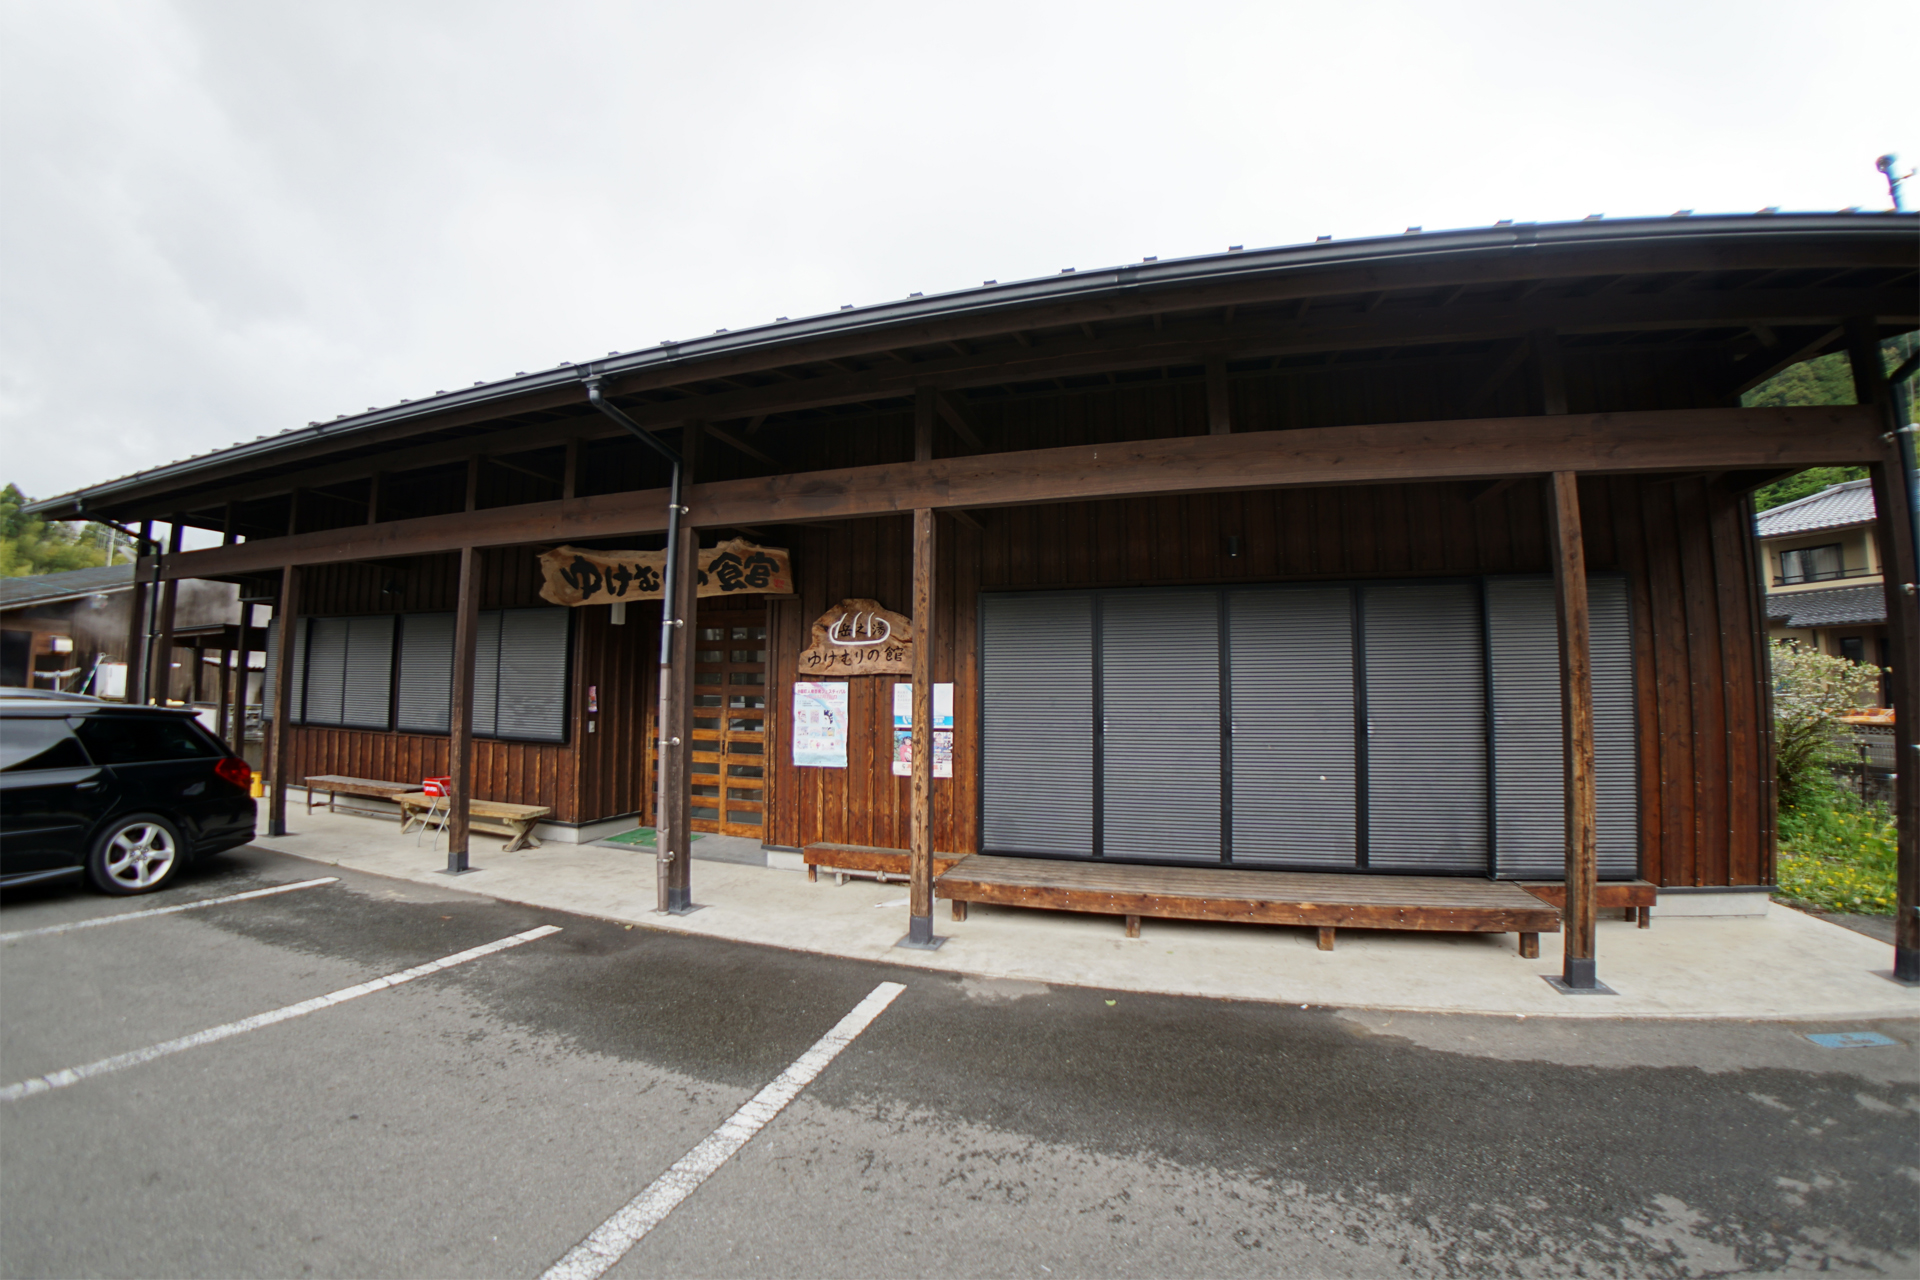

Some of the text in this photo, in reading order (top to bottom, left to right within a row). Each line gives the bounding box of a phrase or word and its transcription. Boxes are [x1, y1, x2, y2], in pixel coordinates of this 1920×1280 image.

[559, 551, 780, 600] ゆけむ館
[808, 646, 904, 669] ゆけむりの館
